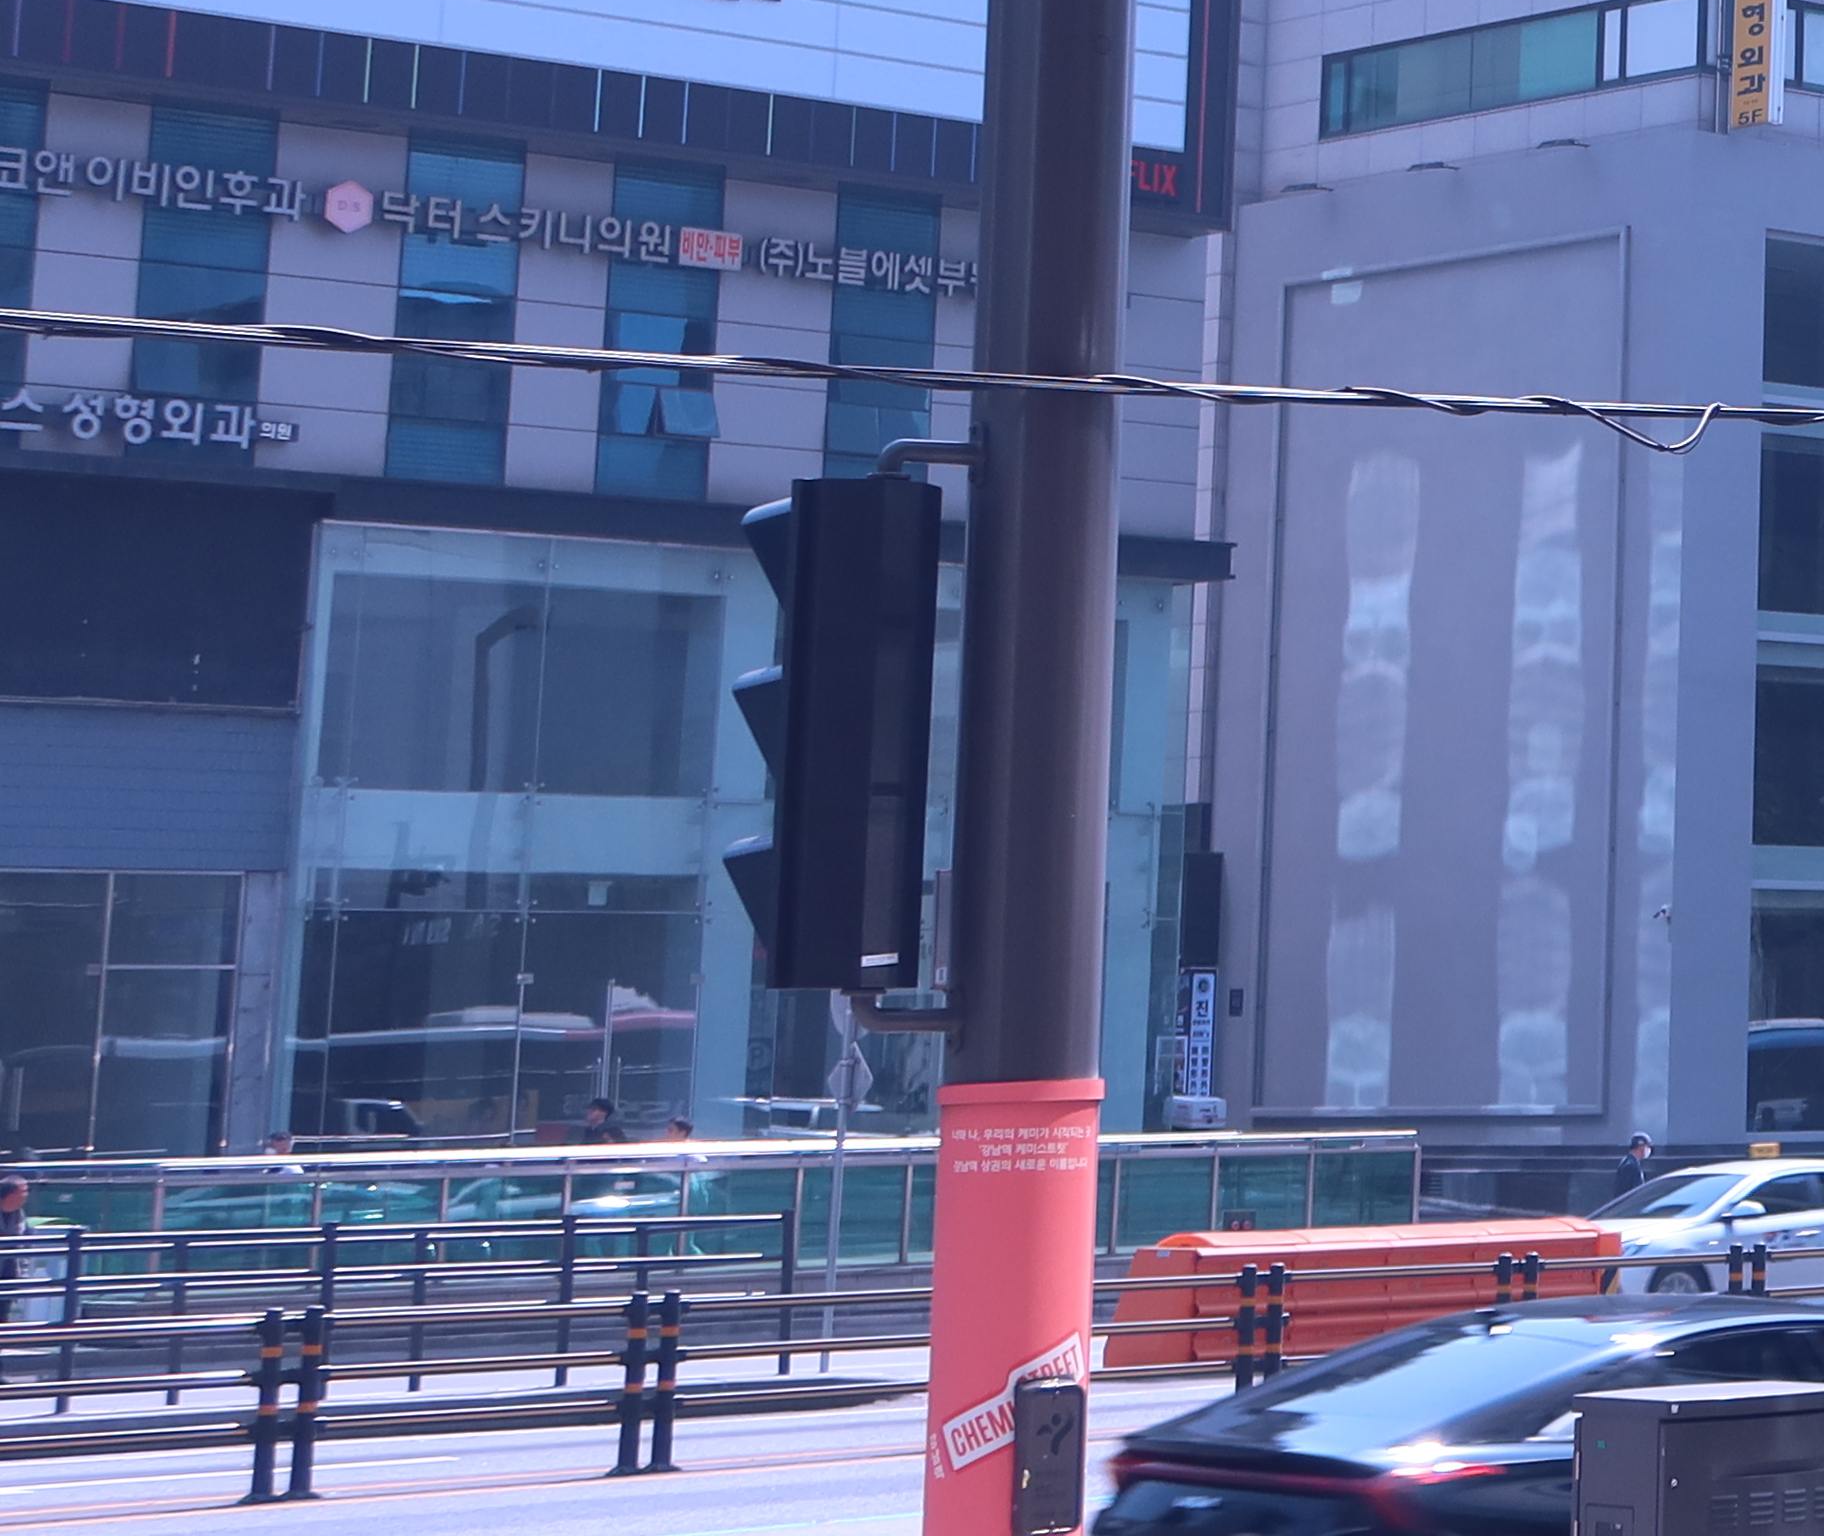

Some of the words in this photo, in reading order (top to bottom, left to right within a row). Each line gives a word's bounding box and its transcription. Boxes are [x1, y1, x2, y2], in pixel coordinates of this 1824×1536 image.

[1737, 106, 1764, 126] 5F
[86, 154, 306, 222] 이비인후과
[382, 189, 462, 239] 닥터
[476, 200, 671, 265] 스키니의원
[62, 390, 258, 451] 성형외과
[260, 420, 293, 442] 의원
[983, 1128, 1015, 1140] 우리의
[1017, 1127, 1050, 1140] 케미가
[981, 1158, 1012, 1172] 상권의
